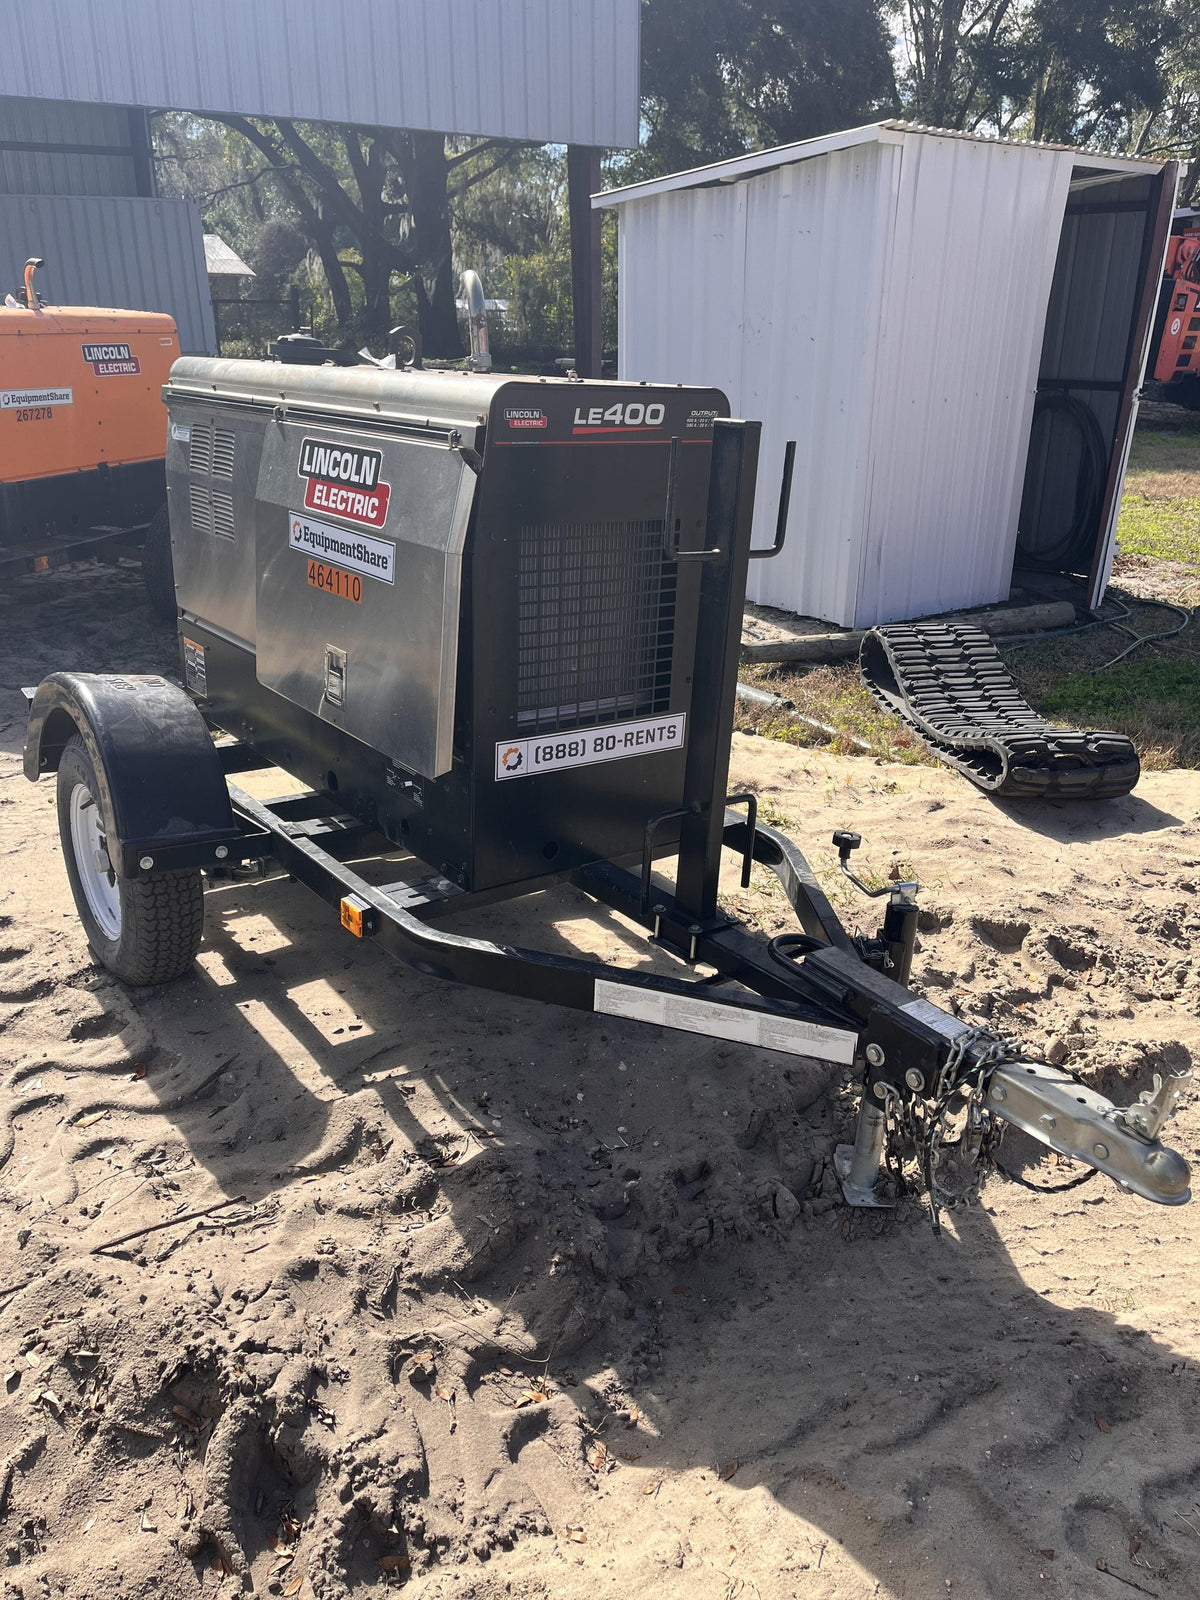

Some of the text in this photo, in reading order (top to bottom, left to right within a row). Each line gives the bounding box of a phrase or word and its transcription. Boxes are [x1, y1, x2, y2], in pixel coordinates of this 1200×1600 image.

[84, 346, 129, 361] LINCOLN
[98, 362, 136, 374] ELECTRIC
[11, 391, 70, 405] EquipmentShare
[16, 407, 52, 422] 267278
[506, 410, 540, 418] LINCOLN
[573, 403, 665, 425] LE400
[302, 445, 377, 486] LINCOLN
[313, 484, 379, 519] ELECTRIC
[303, 526, 388, 570] EquipmentShare
[308, 562, 361, 602] 464110
[534, 724, 677, 765] (888) 80-RENTS
